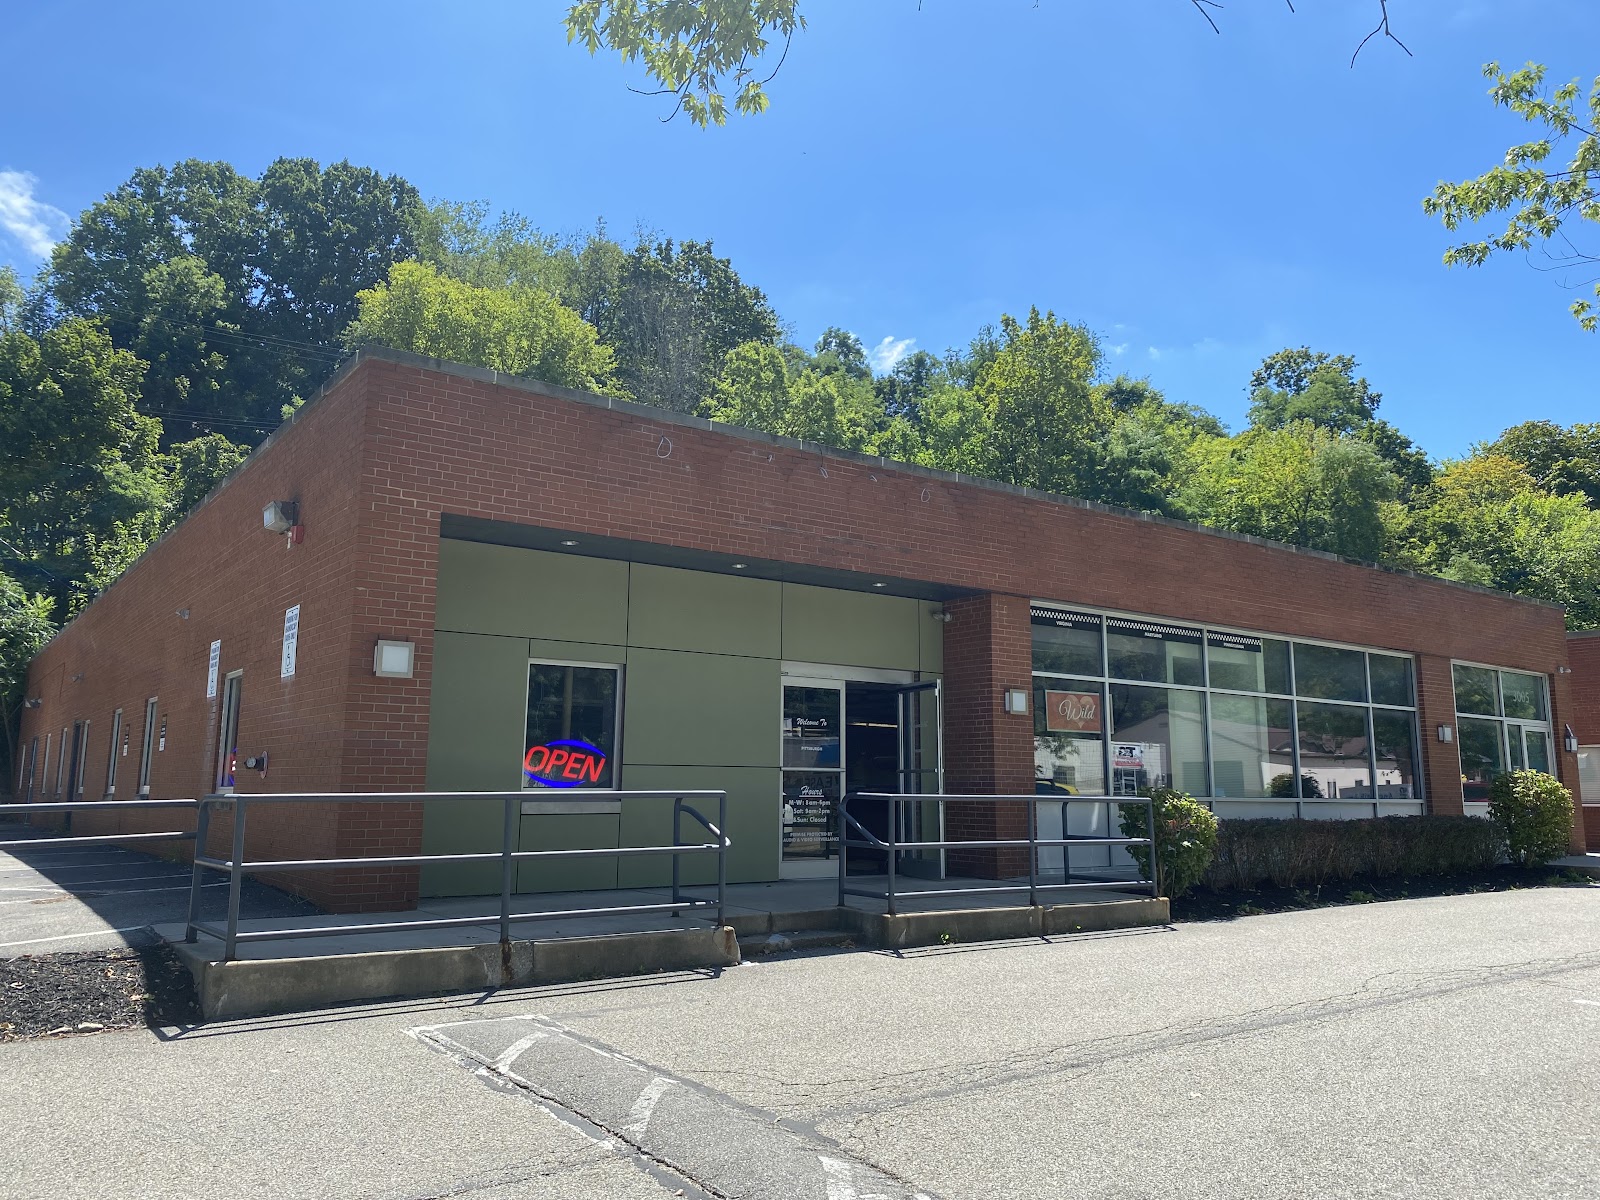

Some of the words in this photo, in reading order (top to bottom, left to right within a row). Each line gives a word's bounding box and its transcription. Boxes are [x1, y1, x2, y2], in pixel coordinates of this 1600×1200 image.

[1058, 699, 1096, 721] Wild
[796, 717, 819, 726] Welcome
[819, 718, 828, 727] To
[523, 745, 607, 783] OPEN
[800, 785, 823, 796] Hours
[809, 815, 827, 823] Closed
